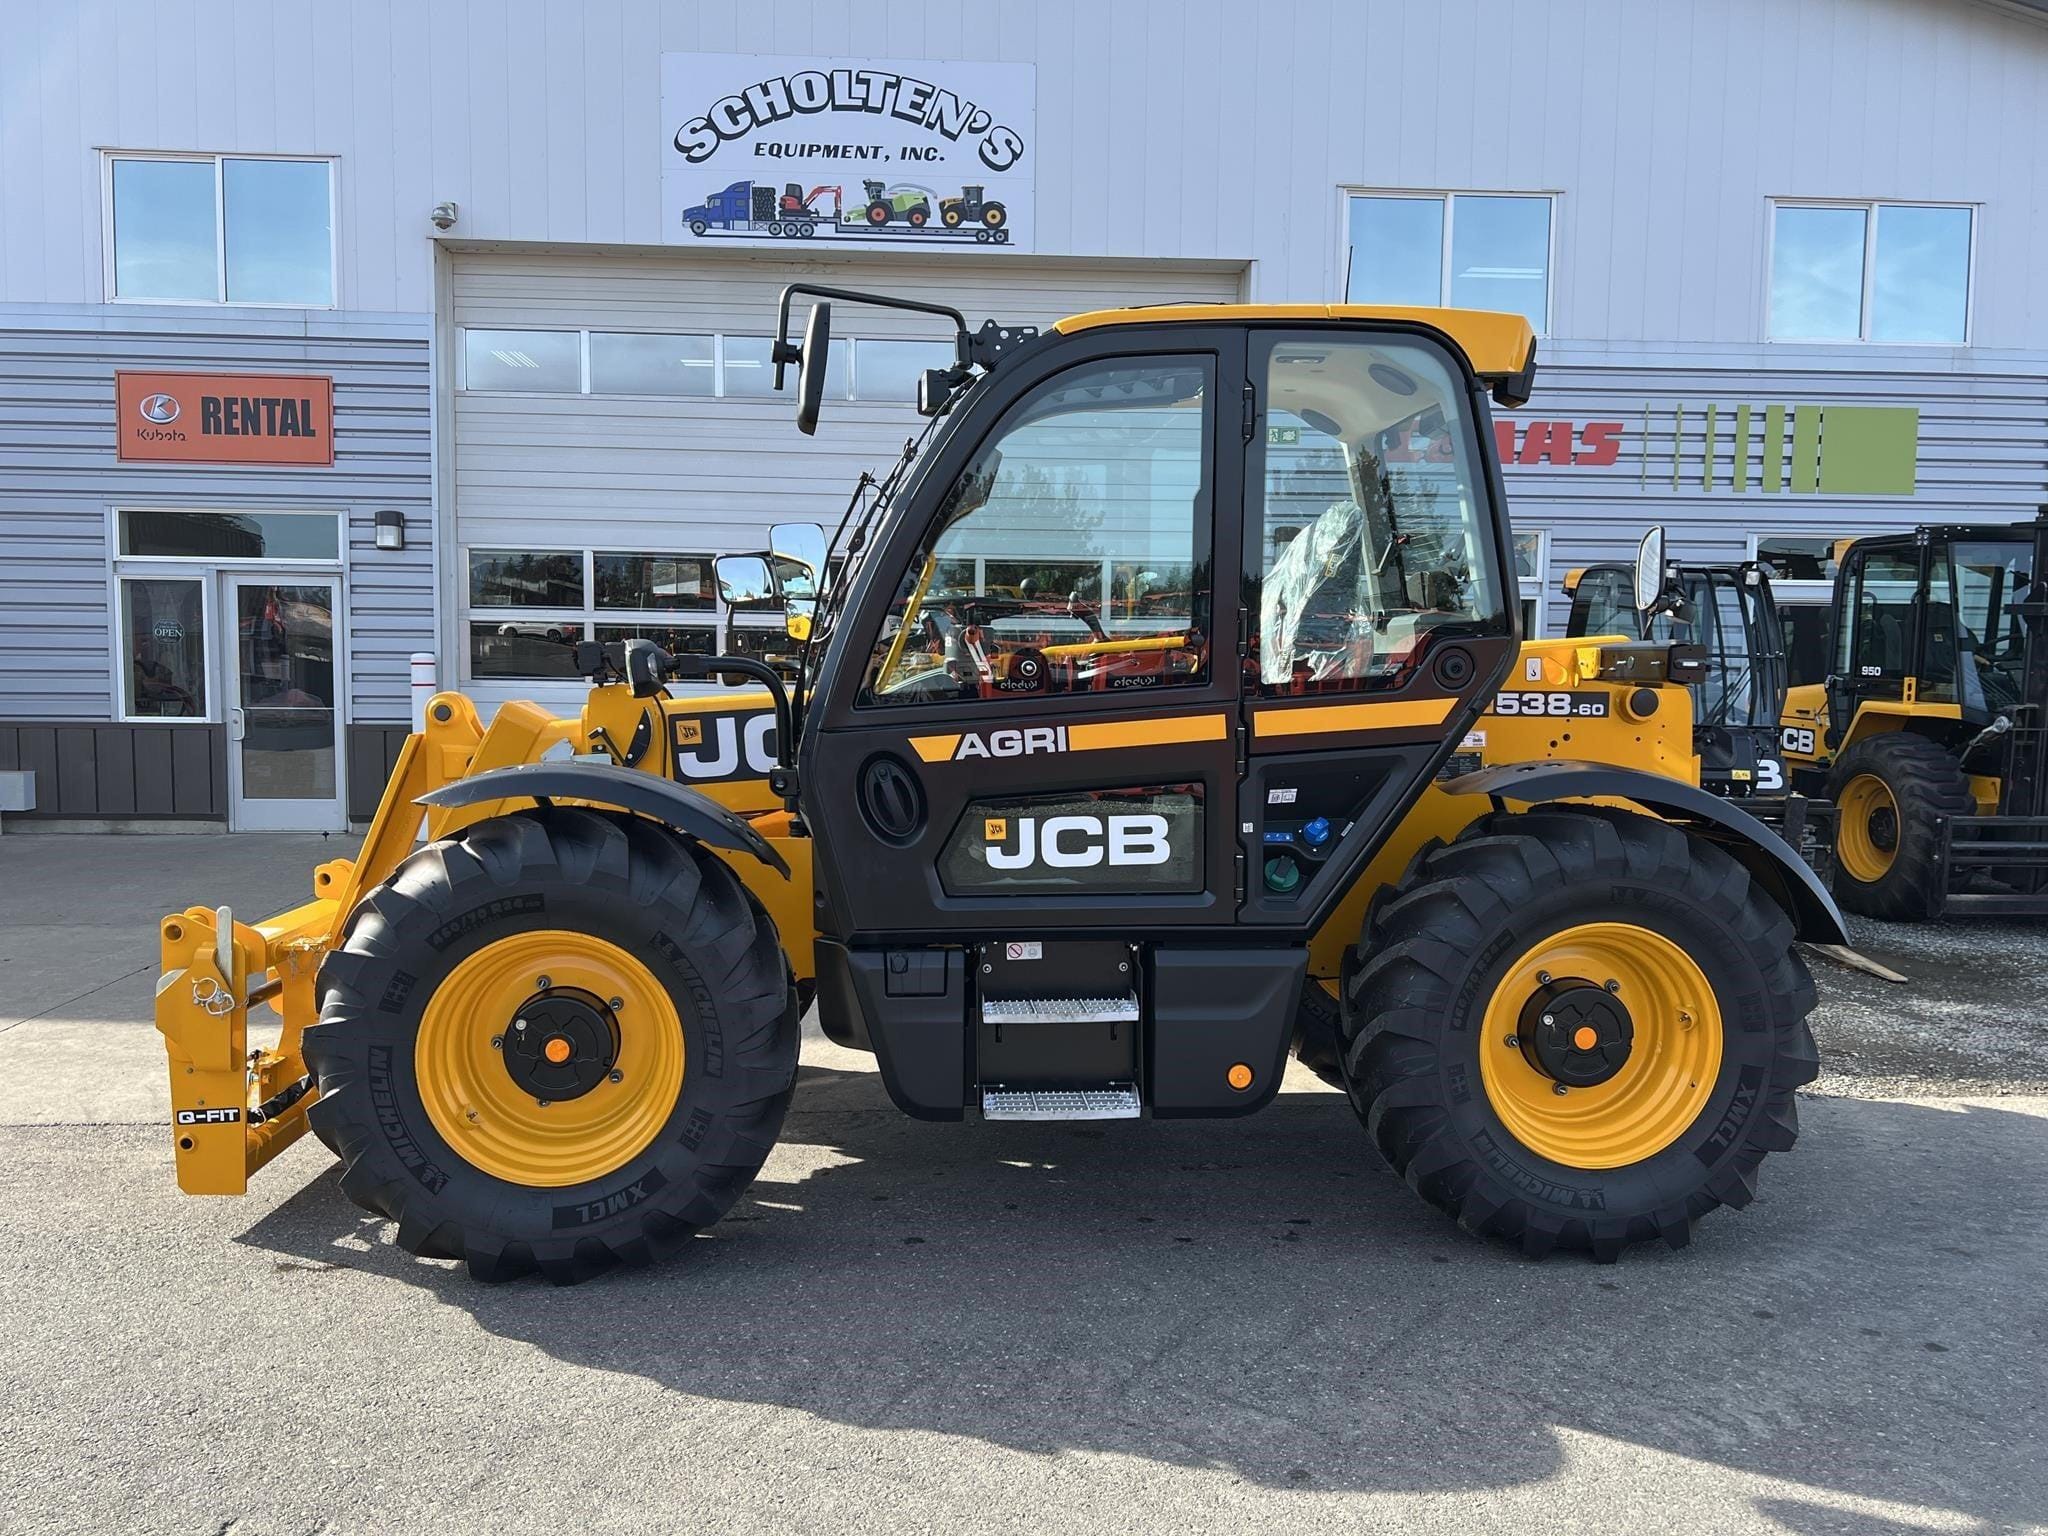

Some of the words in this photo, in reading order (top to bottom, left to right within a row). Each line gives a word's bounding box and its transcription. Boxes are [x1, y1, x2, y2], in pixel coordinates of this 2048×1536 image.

[674, 70, 1024, 171] SCHOLTEN'S
[754, 142, 890, 162] EQUIPMENT,
[900, 146, 946, 161] INC.
[201, 396, 316, 437] RENTAL
[136, 429, 188, 442] Kubota
[154, 628, 183, 637] OPEN
[1861, 666, 1881, 676] 950
[955, 726, 1067, 760] AGRI
[1780, 728, 1814, 753] CB
[985, 815, 1170, 869] JCB
[674, 958, 721, 1075] MICHELIN
[178, 1109, 238, 1124] Q-FIT
[369, 1046, 425, 1168] MICHELIN
[1711, 1083, 1753, 1149] XMCL
[575, 1181, 648, 1222] XMCL
